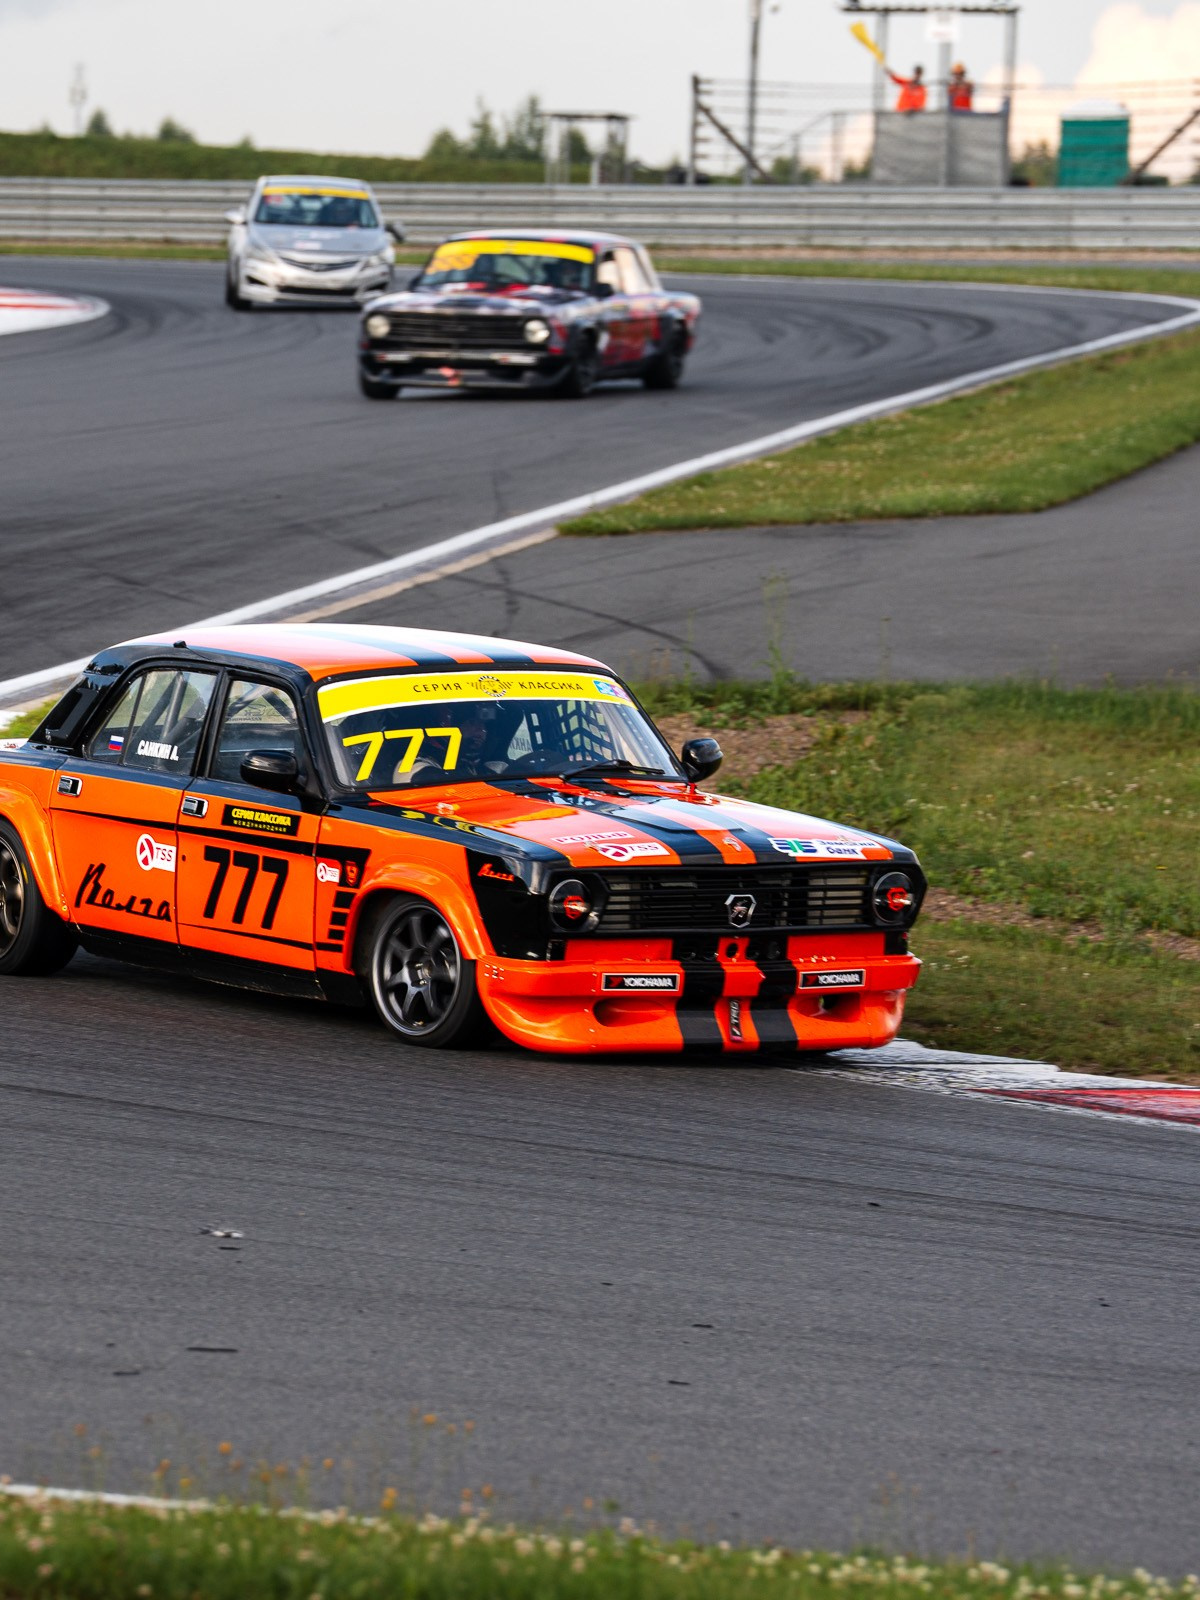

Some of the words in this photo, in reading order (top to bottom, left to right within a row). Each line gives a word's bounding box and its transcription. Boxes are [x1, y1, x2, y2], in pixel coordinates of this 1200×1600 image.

[413, 682, 463, 693] СЕРИЯ
[519, 681, 584, 691] КЛАССИКА
[342, 727, 462, 782] 777
[231, 808, 255, 821] СЕРИЯ
[254, 811, 292, 826] КЛАССИКА
[155, 847, 173, 862] TSS
[74, 863, 172, 922] Волга
[203, 845, 289, 931] 777
[623, 977, 674, 988] YOKOHAMA
[817, 973, 860, 985] YOKOHAMA
